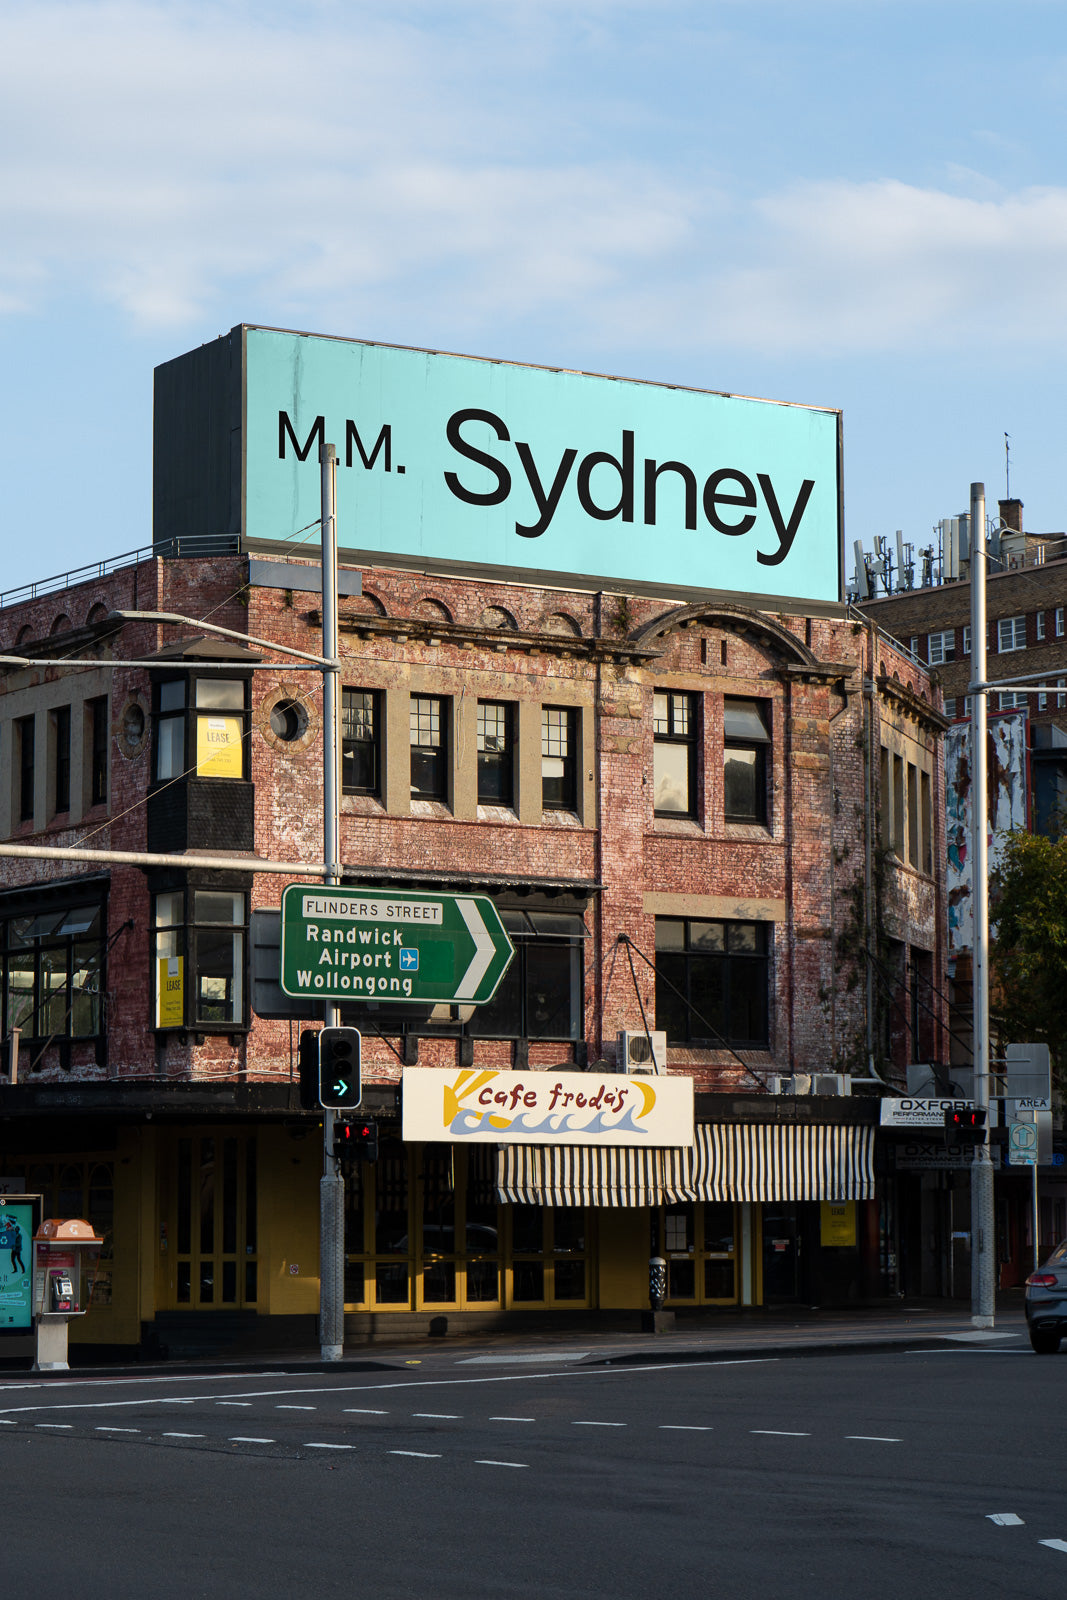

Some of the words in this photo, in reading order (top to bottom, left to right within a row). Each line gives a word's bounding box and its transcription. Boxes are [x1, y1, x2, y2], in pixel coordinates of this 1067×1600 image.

[444, 408, 816, 567] Sydney
[207, 731, 230, 743] LEASE
[306, 901, 378, 916] FLINDERS
[386, 905, 439, 919] STREET
[306, 925, 403, 946] Randwick
[318, 948, 392, 970] Airport
[166, 979, 181, 991] LEASE
[297, 970, 413, 996] Wollongong
[478, 1083, 537, 1111] cafe
[548, 1083, 629, 1113] freda's
[1019, 1099, 1047, 1108] AREA
[905, 1145, 974, 1156] OXFOR
